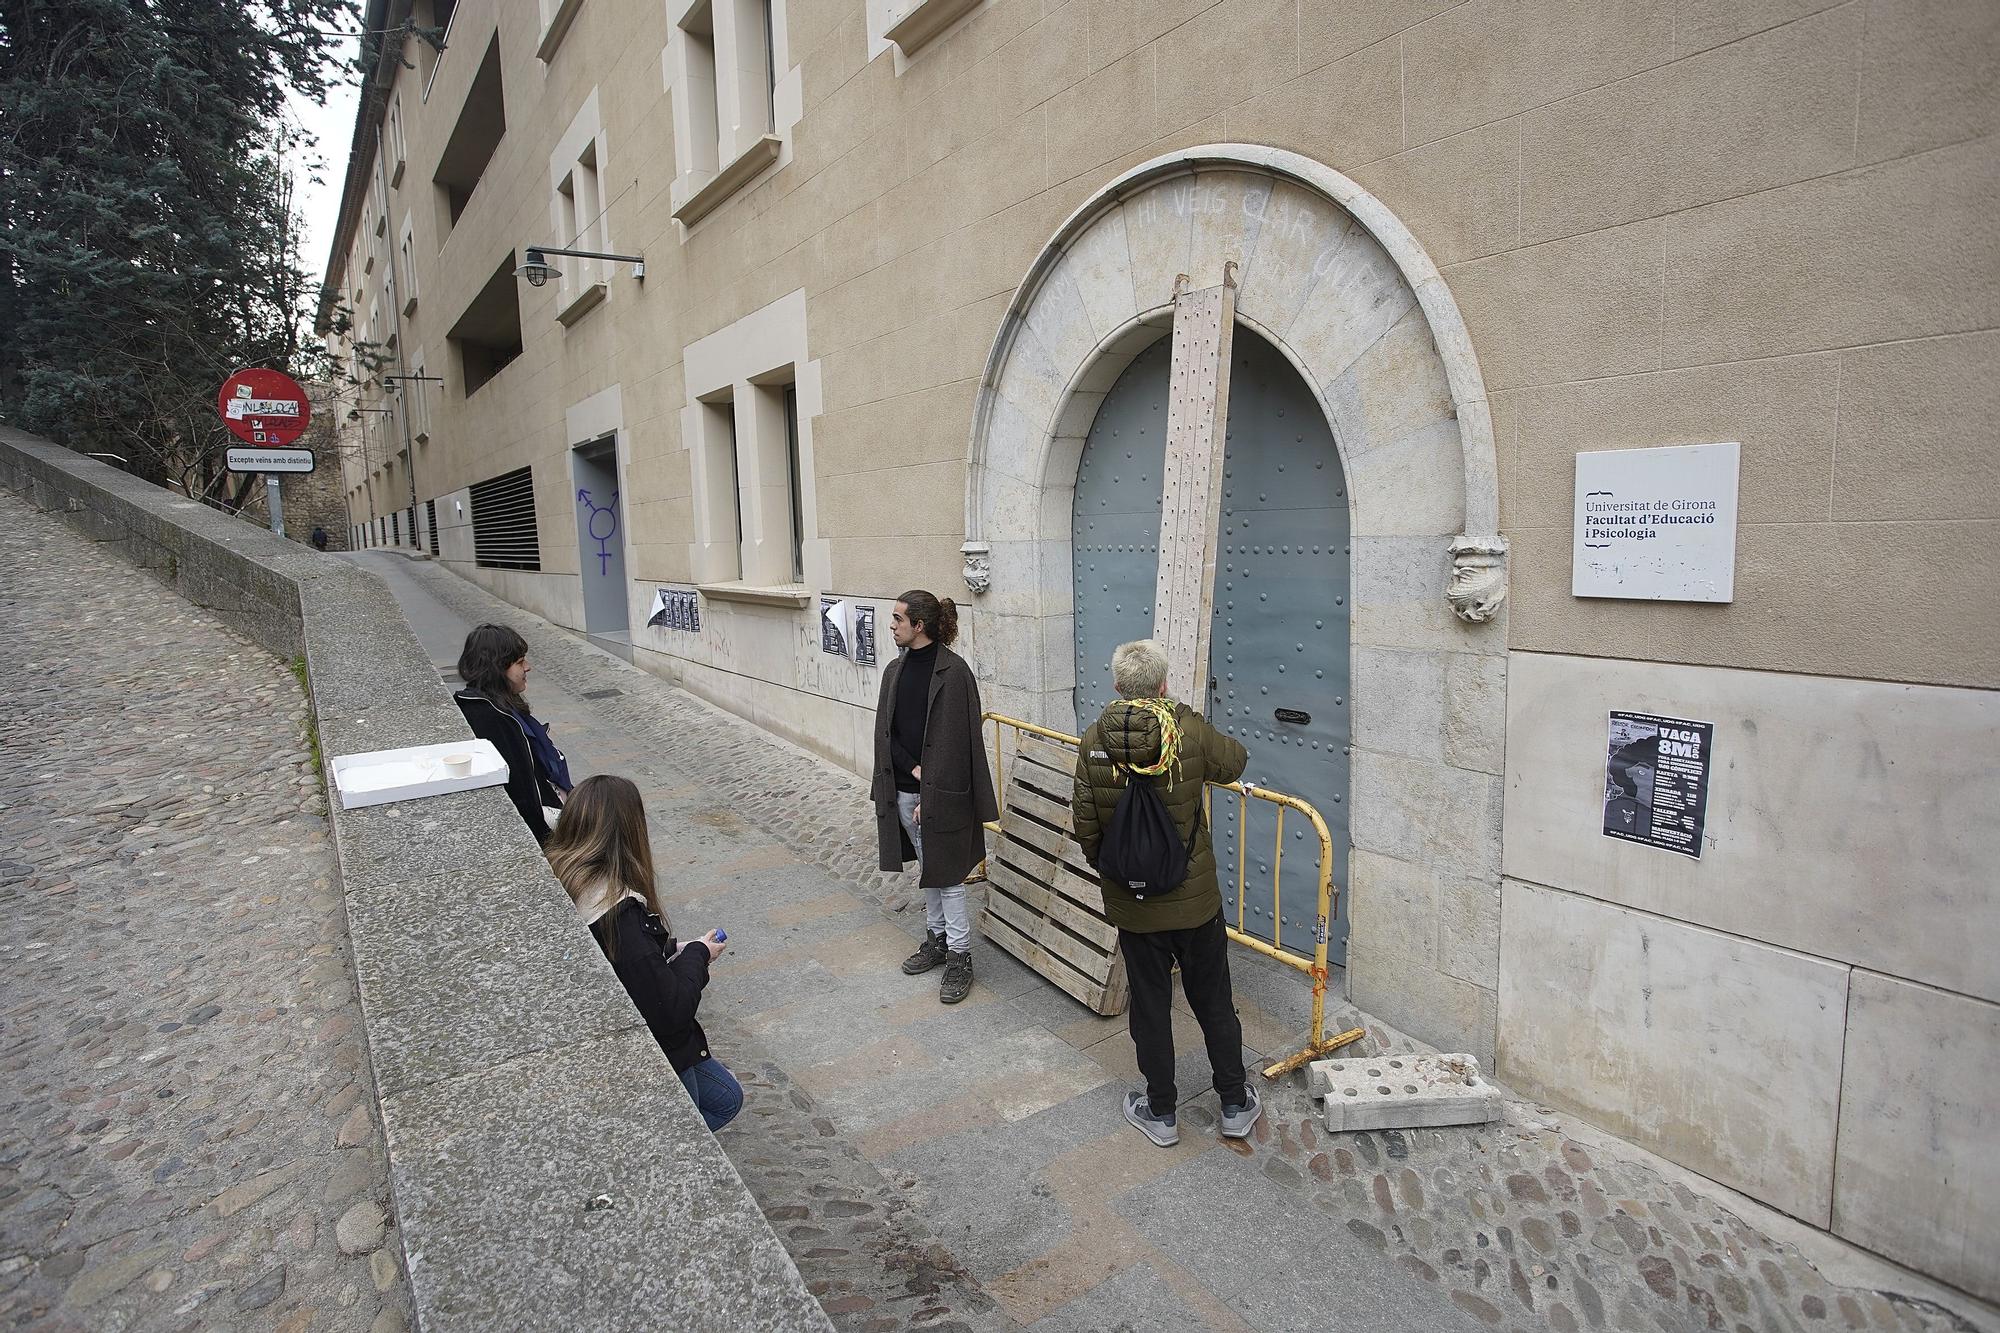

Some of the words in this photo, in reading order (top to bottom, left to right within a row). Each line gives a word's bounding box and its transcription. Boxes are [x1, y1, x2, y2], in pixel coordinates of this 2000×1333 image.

[229, 456, 254, 464] Excepte
[1586, 501, 1651, 512] Universitat
[1653, 500, 1669, 511] de
[1671, 499, 1716, 511] Girona
[1585, 514, 1636, 525] Facultat
[1638, 512, 1715, 525] d'Educació
[1585, 528, 1589, 539] i
[1591, 528, 1656, 540] Psicologia
[1658, 727, 1701, 743] VAGA
[1657, 738, 1692, 757] 8M
